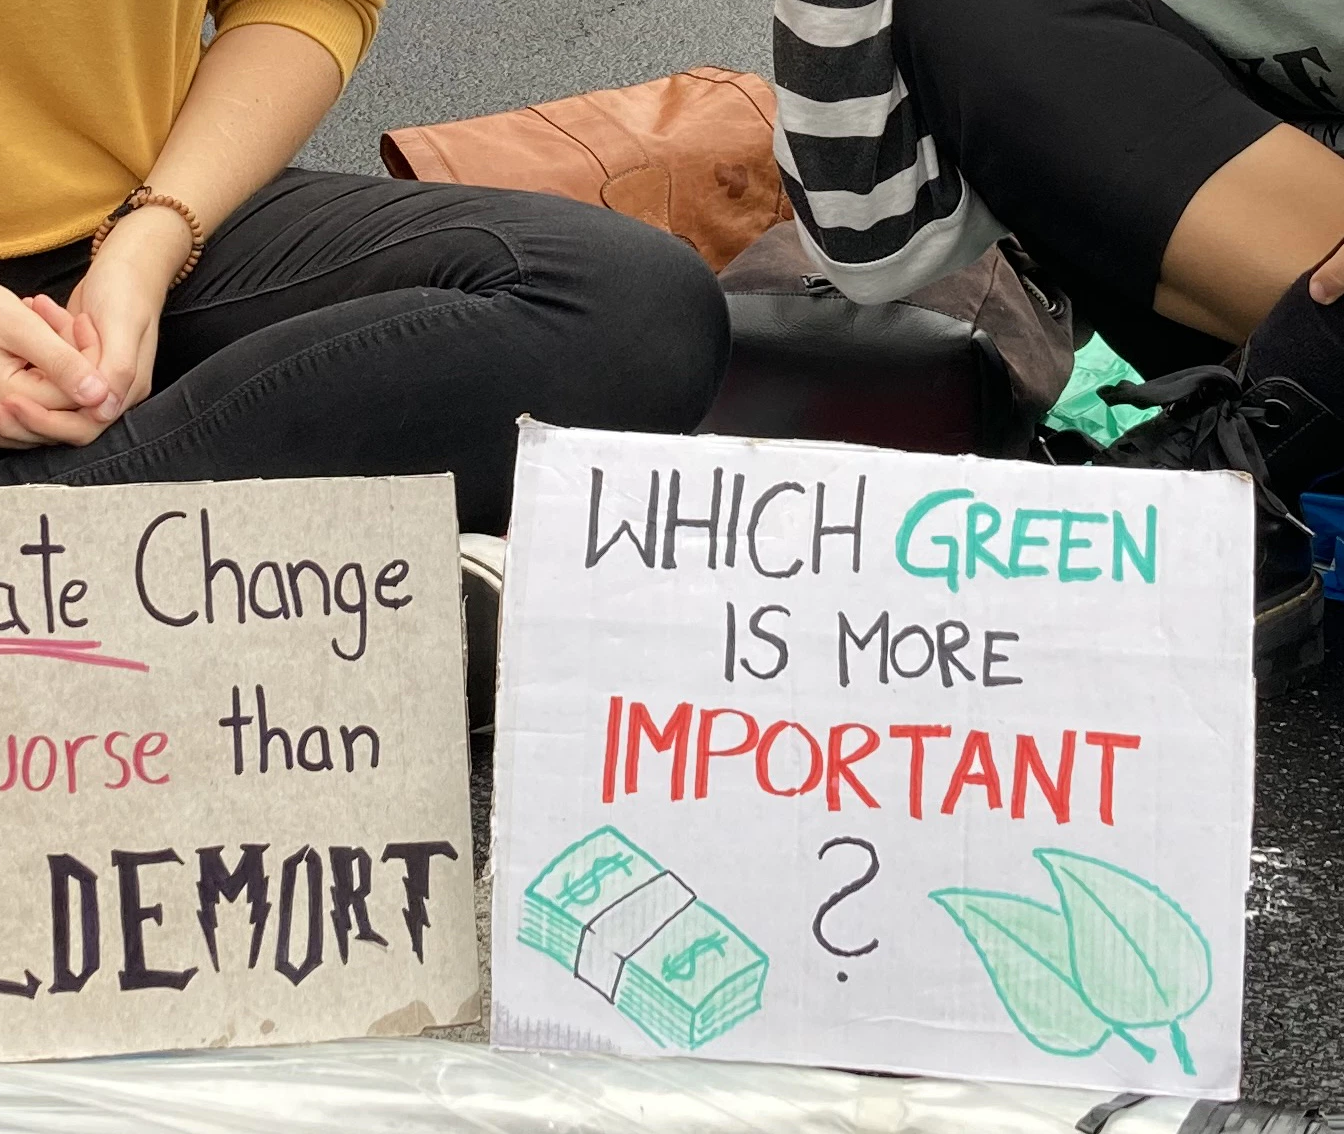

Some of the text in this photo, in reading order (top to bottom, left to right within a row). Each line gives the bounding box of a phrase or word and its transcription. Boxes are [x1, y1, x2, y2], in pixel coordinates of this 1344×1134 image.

[136, 508, 413, 662] Change
[584, 466, 1158, 593] WHICH GREEN
[724, 601, 1024, 688] IS MORE
[218, 684, 381, 776] than
[601, 695, 1142, 827] IMPORTANT
[812, 835, 880, 983] ?
